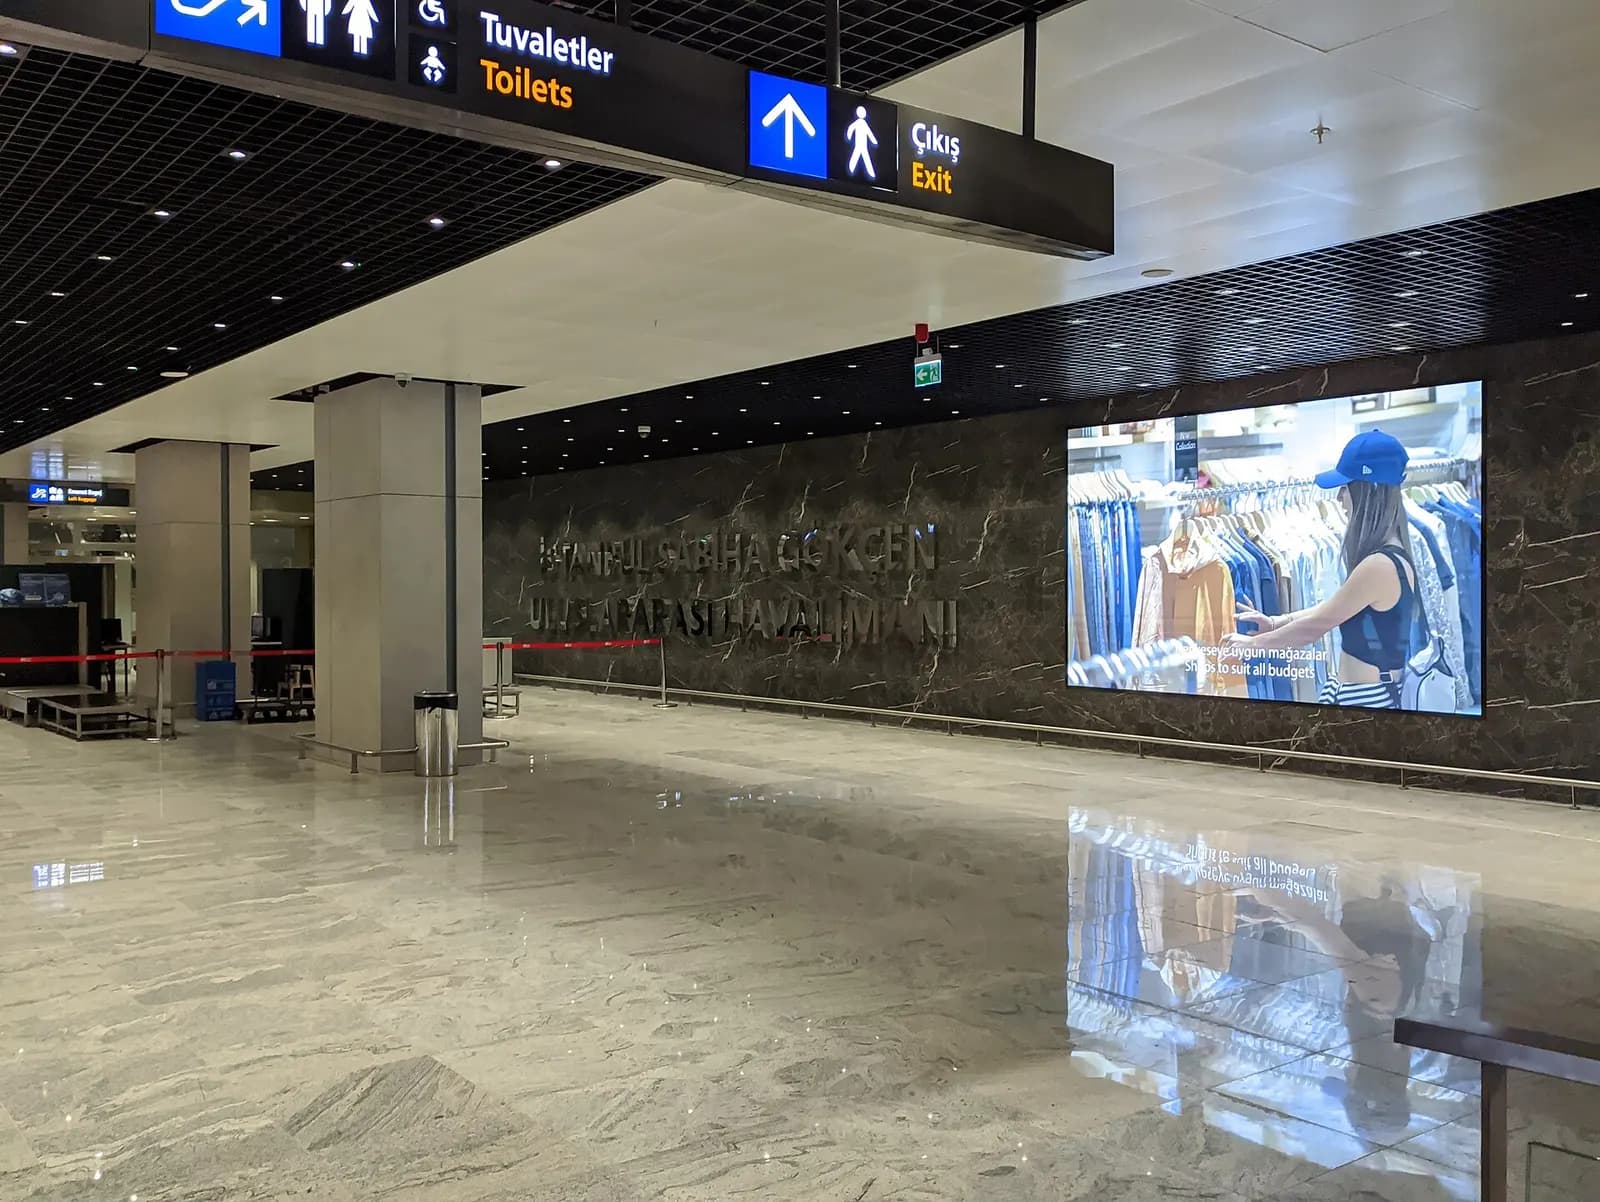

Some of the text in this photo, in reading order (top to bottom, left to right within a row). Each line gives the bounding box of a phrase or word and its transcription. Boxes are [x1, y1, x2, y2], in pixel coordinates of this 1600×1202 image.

[480, 11, 613, 73] Tuvaletler
[480, 59, 573, 108] Toilets
[911, 122, 960, 163] Çıkış
[912, 161, 952, 194] Exit
[1185, 660, 1316, 680] Shps to suit all budgets
[1231, 647, 1266, 661] uygun
[1268, 646, 1328, 662] mağazalar
